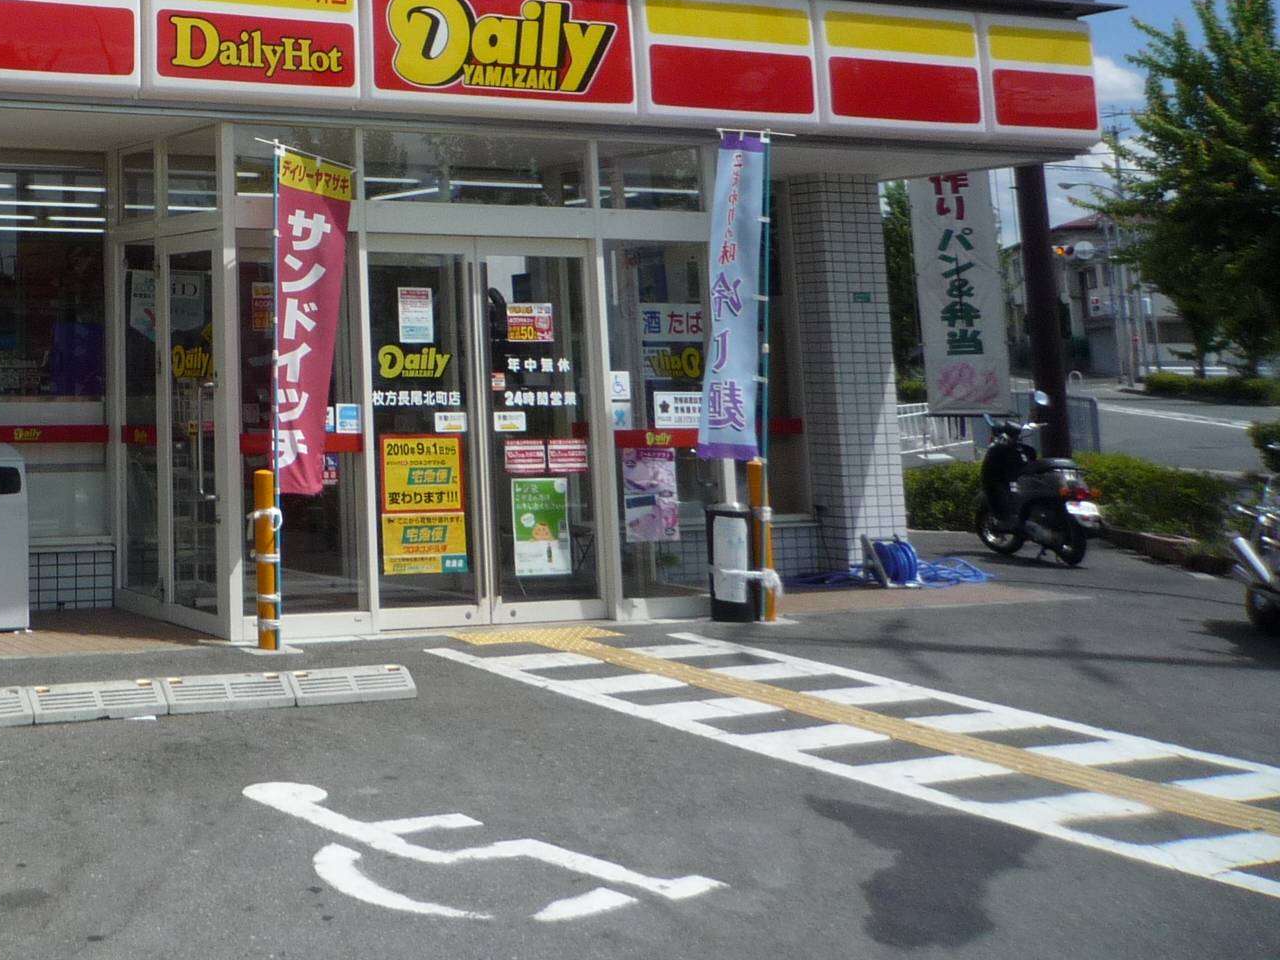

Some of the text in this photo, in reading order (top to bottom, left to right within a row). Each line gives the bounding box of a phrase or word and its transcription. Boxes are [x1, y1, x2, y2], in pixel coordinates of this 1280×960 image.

[462, 62, 558, 91] YAMAZAKI
[282, 160, 350, 195] デイリーヤマザキ
[642, 310, 661, 334] 酒
[272, 209, 332, 470] サンドイッチ
[521, 325, 534, 340] 50
[173, 344, 210, 378] Daily
[378, 344, 451, 379] Daily
[507, 357, 571, 373] 年中無休
[372, 390, 461, 406] 枚方長尾北町店
[504, 391, 577, 406] 24時間営業
[14, 428, 43, 442] Daily
[646, 432, 672, 446] Daily
[411, 468, 449, 484] 宅急便
[388, 491, 459, 505] 変わります!!!
[406, 527, 445, 544] 宅急便
